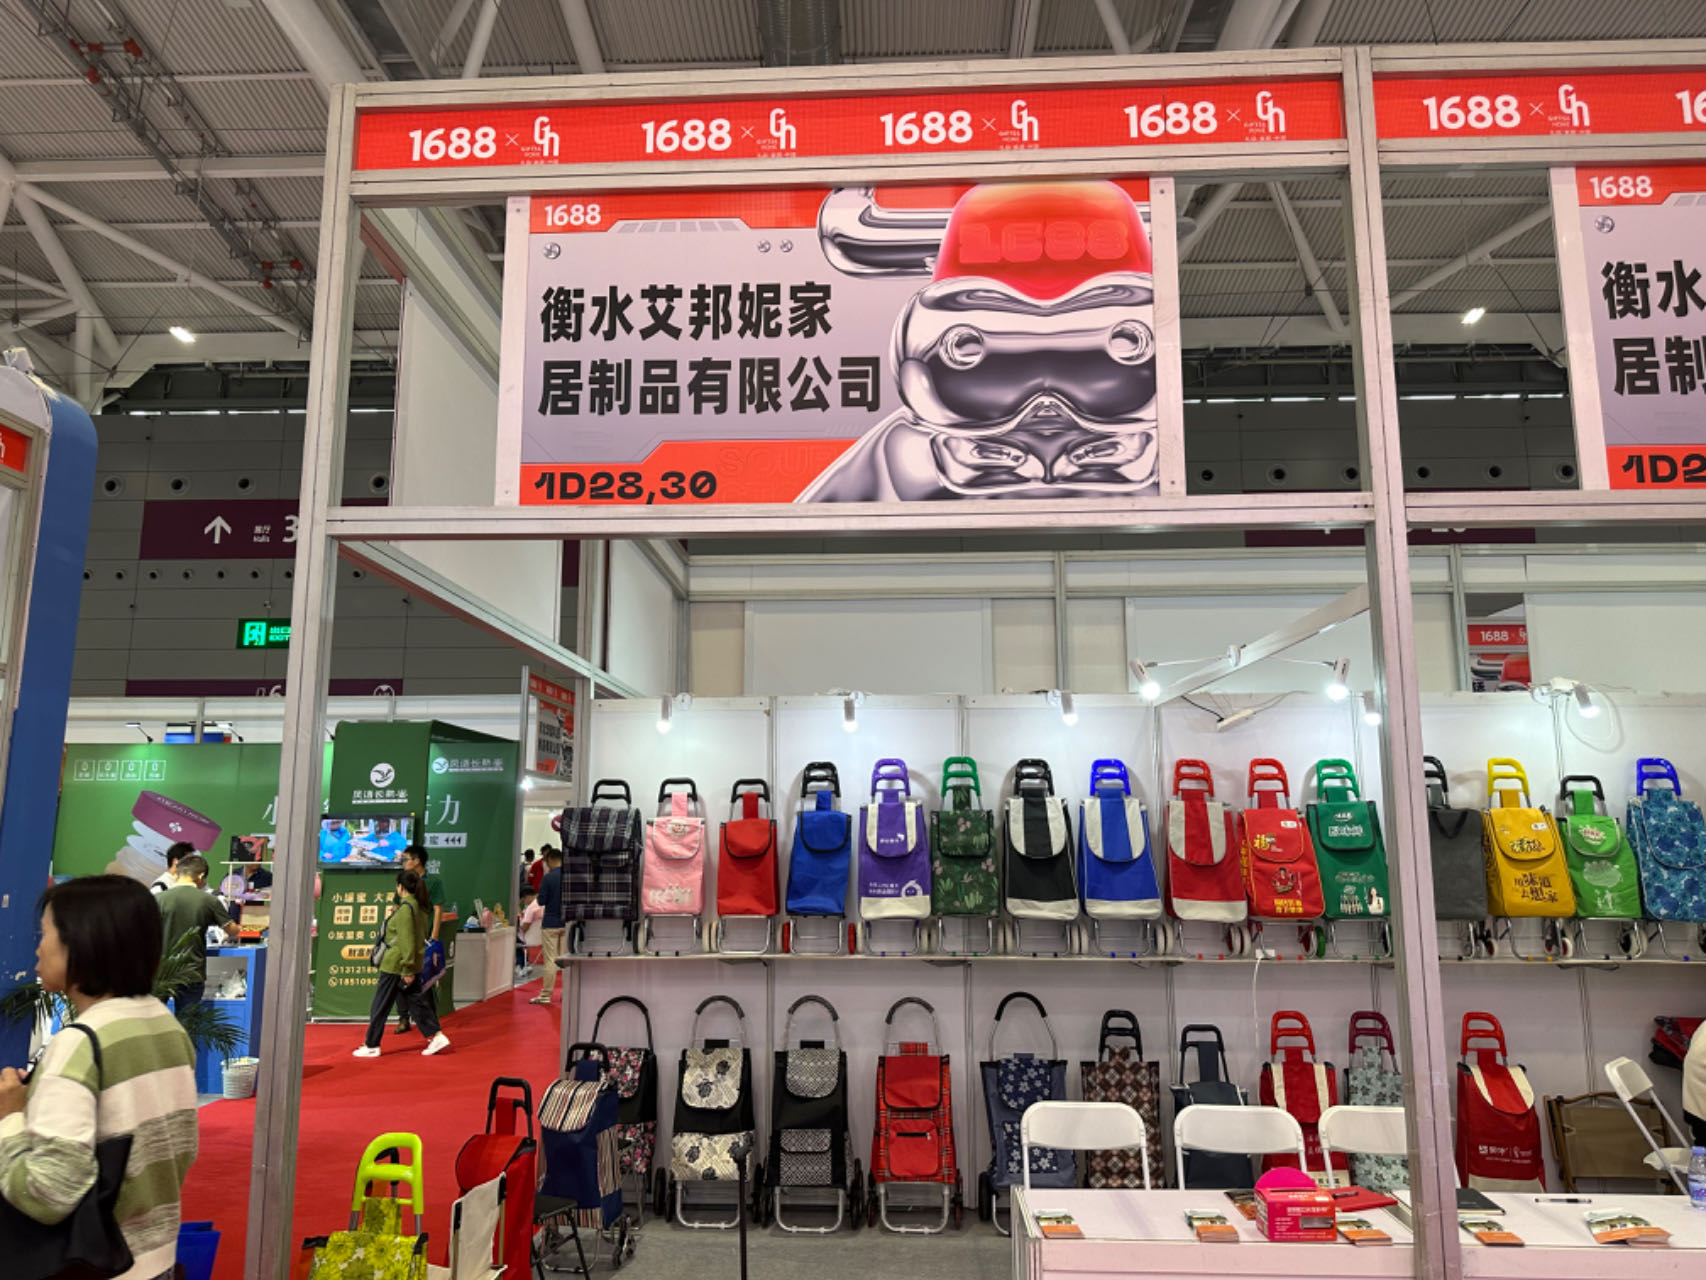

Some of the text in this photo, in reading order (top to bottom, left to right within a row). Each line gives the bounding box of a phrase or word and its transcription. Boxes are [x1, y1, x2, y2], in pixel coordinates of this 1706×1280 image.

[410, 127, 496, 161] 1688
[642, 119, 731, 153] 1688
[880, 111, 972, 146] 1688
[1124, 102, 1217, 138] 1688
[1423, 95, 1520, 129] 1688
[1590, 176, 1653, 198] 1688
[544, 204, 601, 226] 1688
[541, 281, 832, 343] 衡水艾邦妮家
[1602, 260, 1706, 319] 衡水
[538, 356, 880, 416] 居制品有限公司
[1480, 631, 1509, 642] 1688
